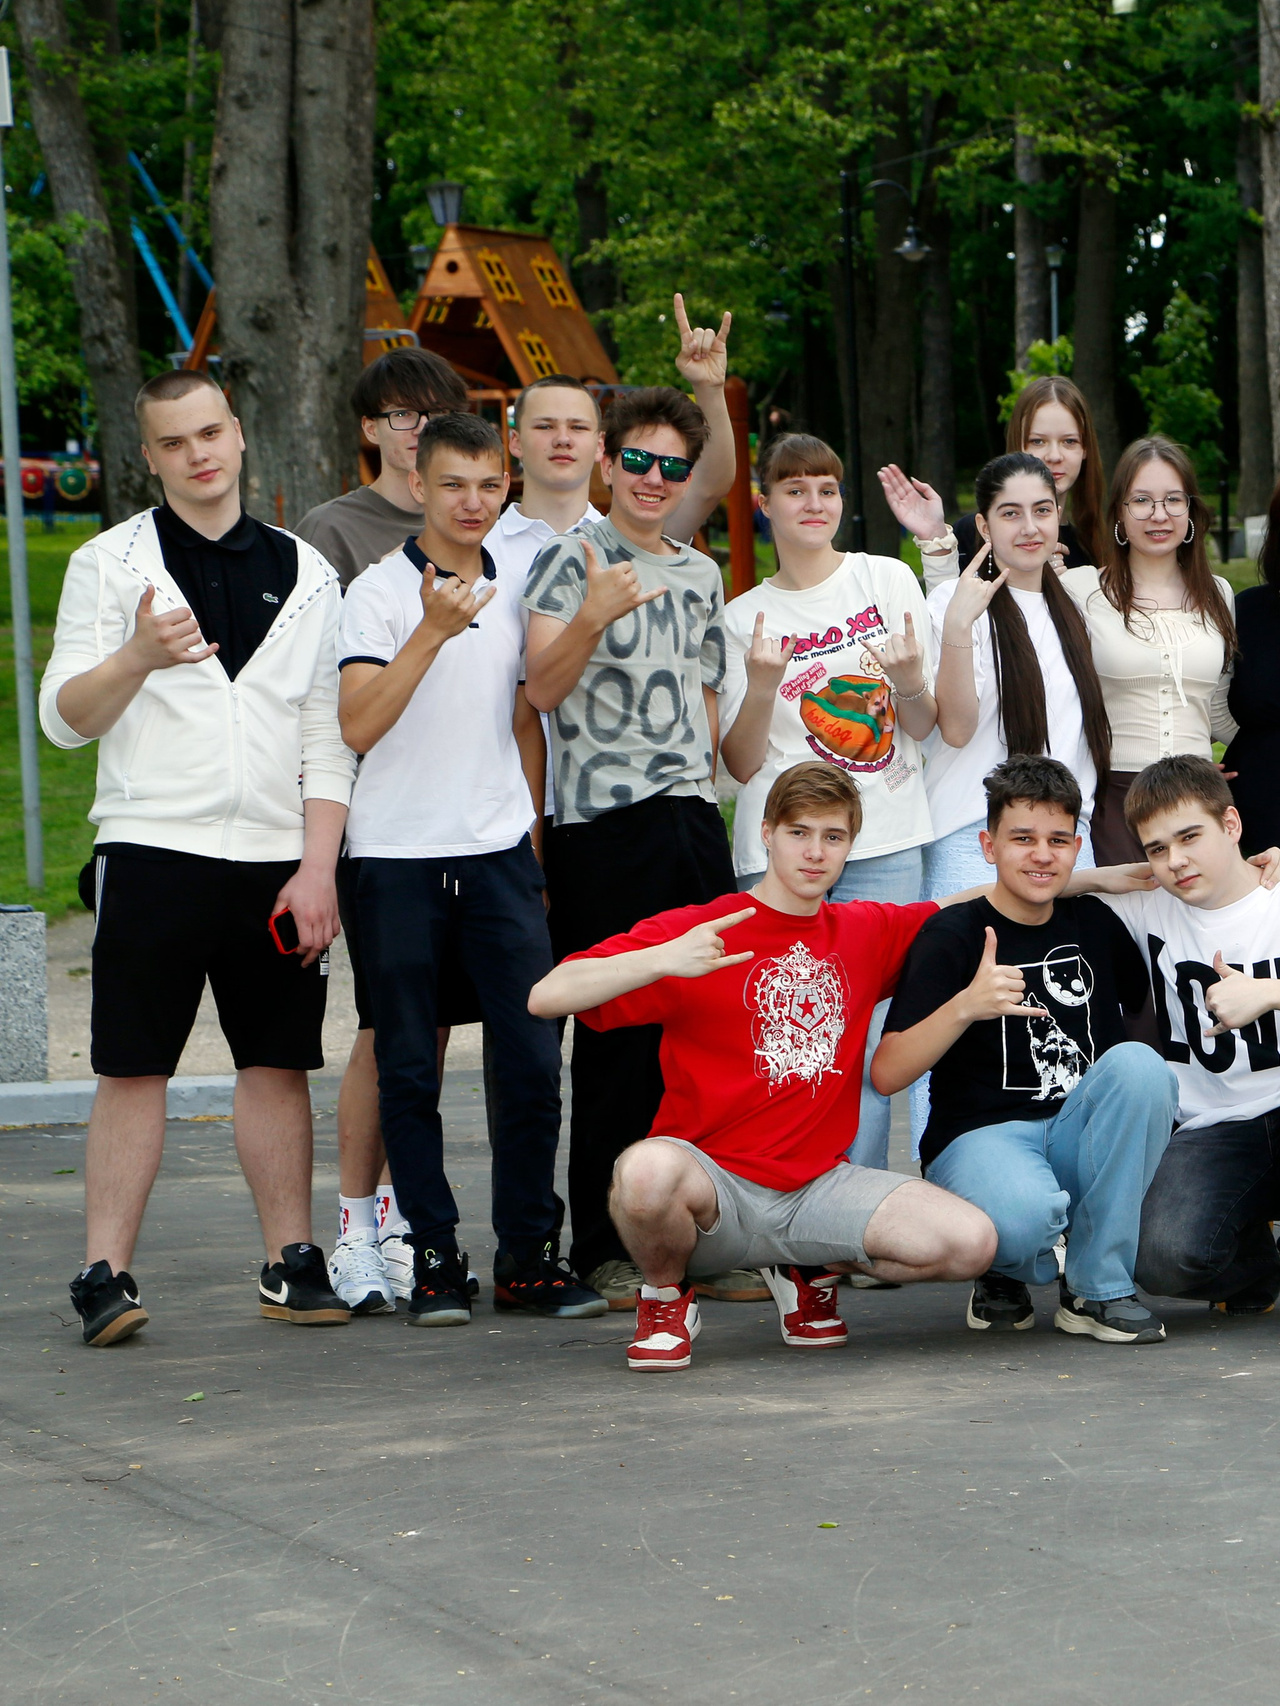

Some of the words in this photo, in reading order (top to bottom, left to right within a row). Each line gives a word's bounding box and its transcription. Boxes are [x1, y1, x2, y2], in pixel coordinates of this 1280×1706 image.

[793, 653, 809, 663] The
[810, 643, 845, 659] moment
[847, 638, 856, 648] of
[805, 708, 827, 729] hot
